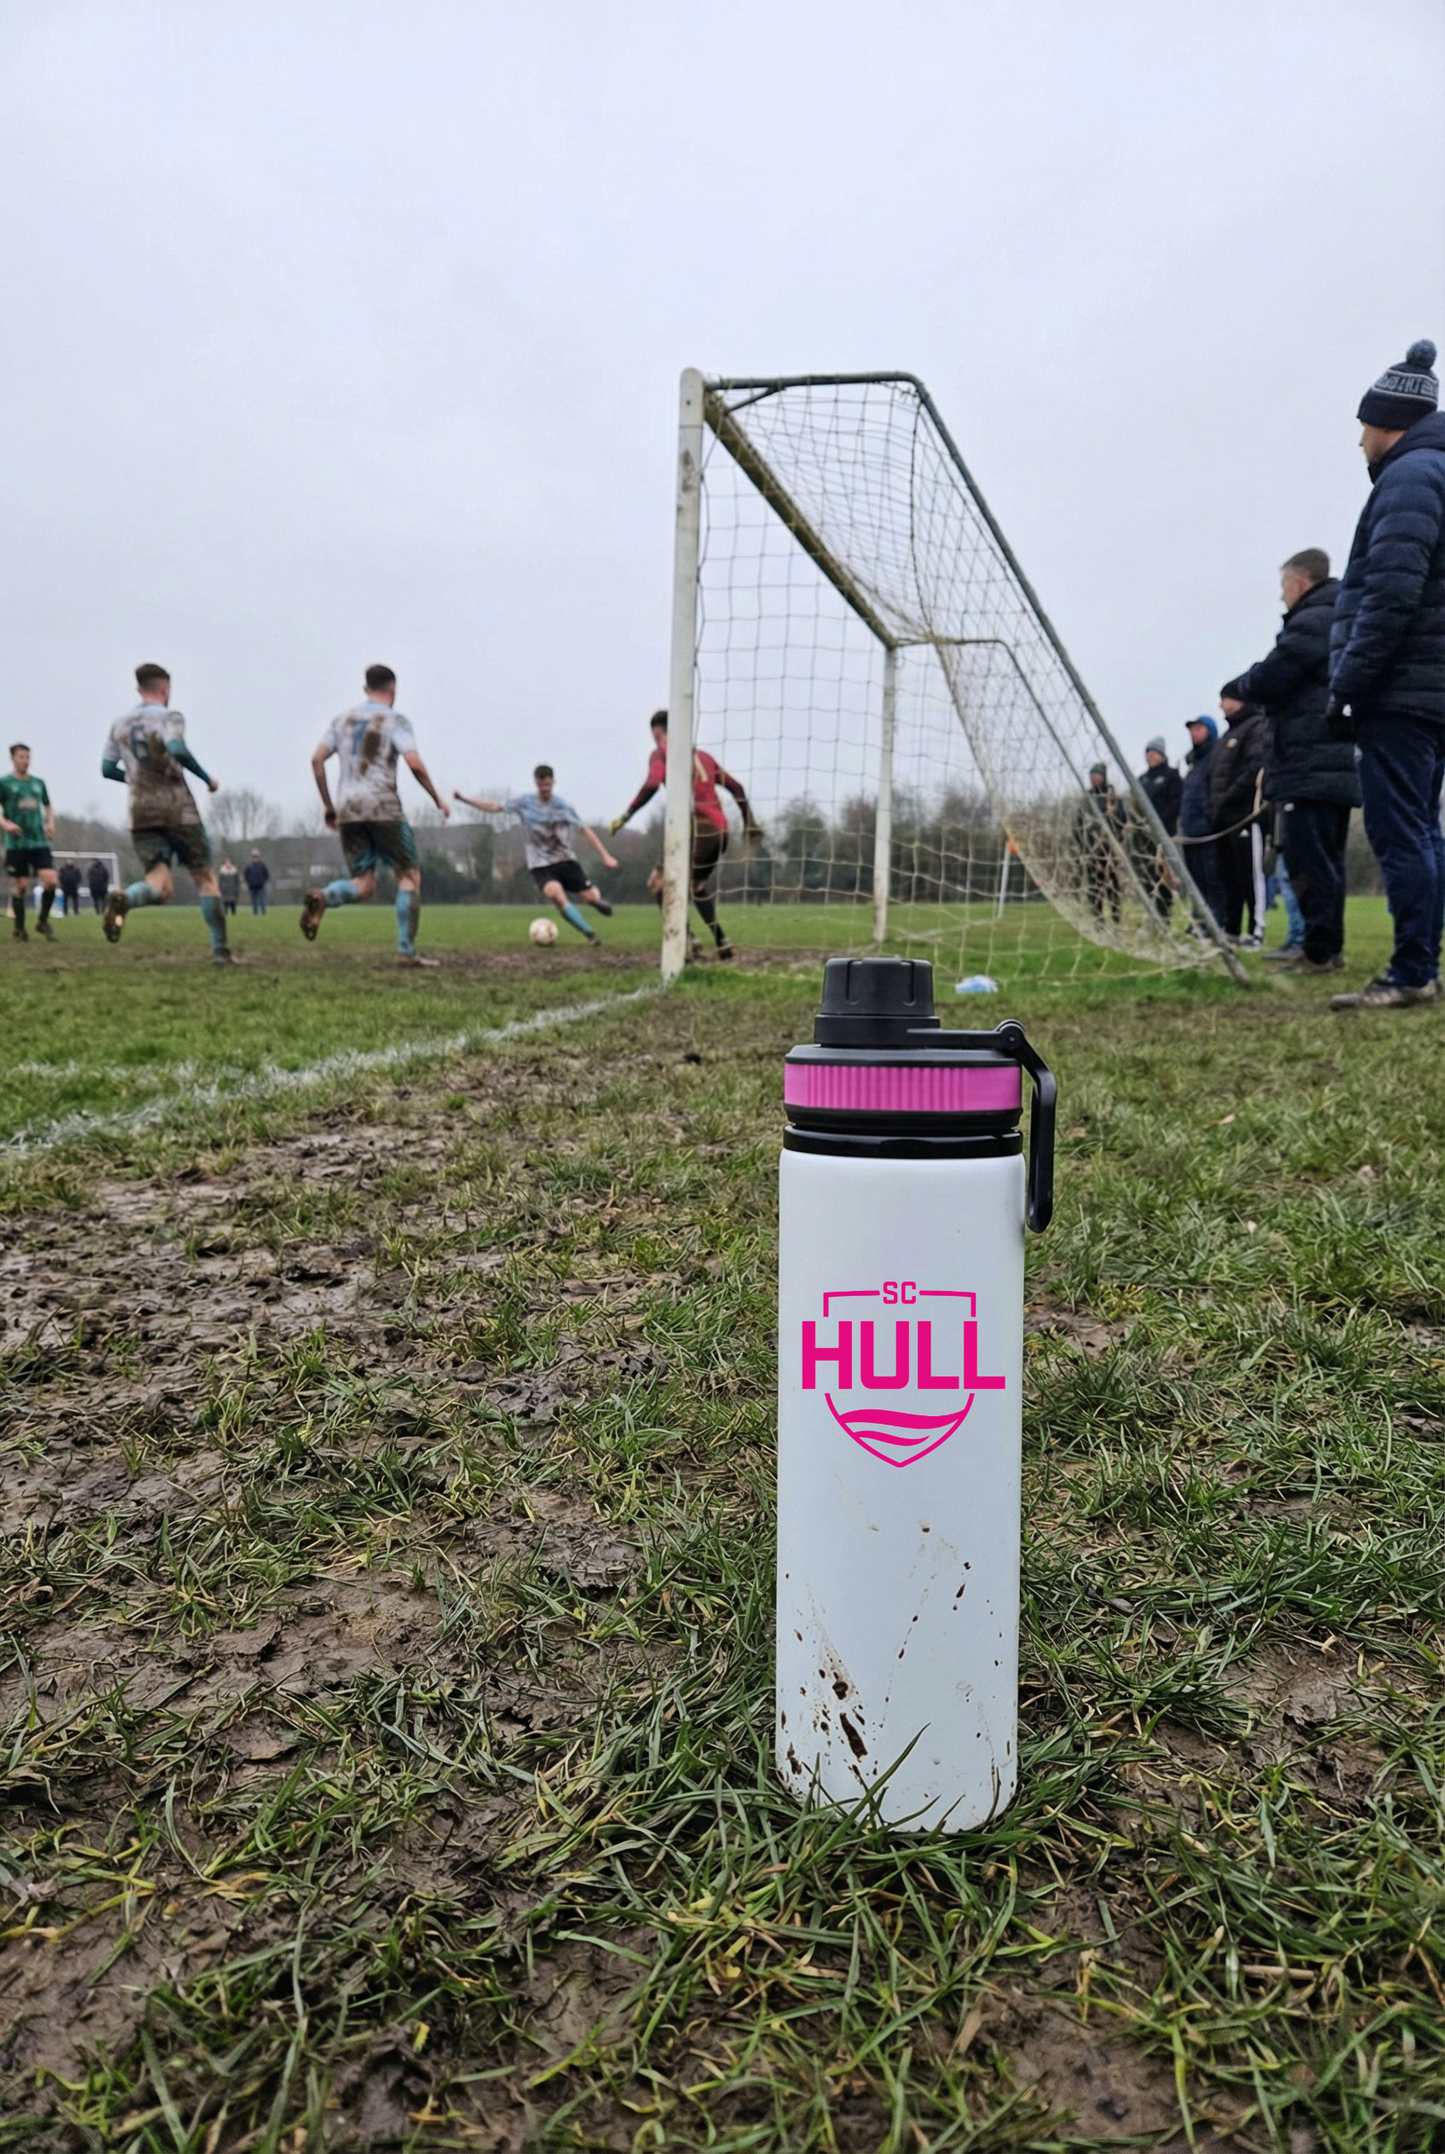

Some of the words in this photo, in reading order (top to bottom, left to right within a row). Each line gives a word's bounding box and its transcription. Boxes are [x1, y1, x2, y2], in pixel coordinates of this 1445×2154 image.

[130, 724, 149, 764] 6
[883, 1281, 916, 1304] SC
[802, 1321, 1005, 1389] HULL
